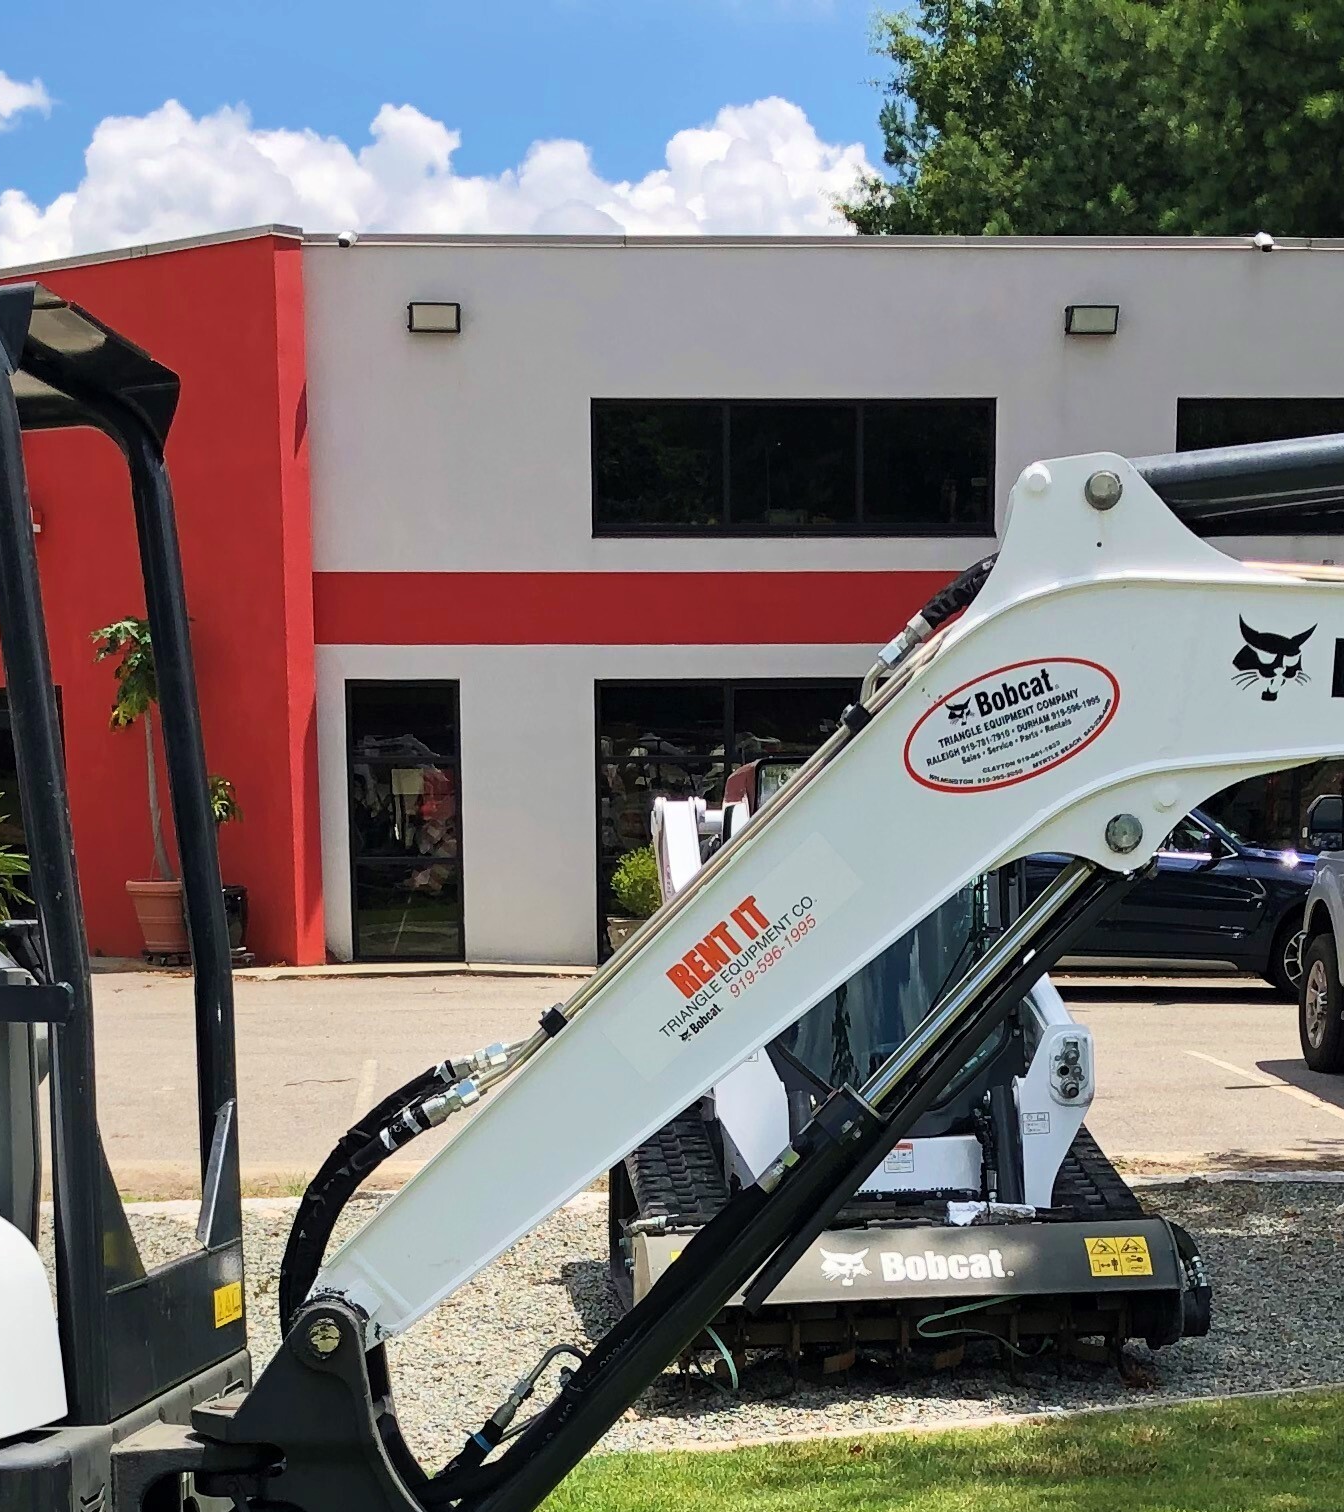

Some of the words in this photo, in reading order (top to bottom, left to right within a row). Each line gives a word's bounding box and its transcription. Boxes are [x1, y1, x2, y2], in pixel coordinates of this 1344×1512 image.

[937, 724, 983, 749] TRIANGLE
[983, 704, 1035, 732] EQUIPMENT
[1036, 688, 1079, 712] COMPANY
[974, 668, 1054, 718] Bobcat
[926, 748, 961, 767] RALEIGH
[1016, 713, 1051, 733] DURHAM
[961, 752, 982, 765] Sales
[986, 740, 1014, 755] Service
[1019, 730, 1039, 743] Parts
[1044, 718, 1072, 734] Rentals
[982, 760, 1016, 774] CLAYTON
[666, 921, 743, 999] RENT
[729, 895, 771, 941] IT
[729, 913, 817, 999] 919-596-1995
[659, 978, 723, 1038] TRIANGLE
[719, 912, 794, 985] EQUIPMENT
[689, 1003, 722, 1035] Bobcat
[879, 1249, 1007, 1282] Bobcat
